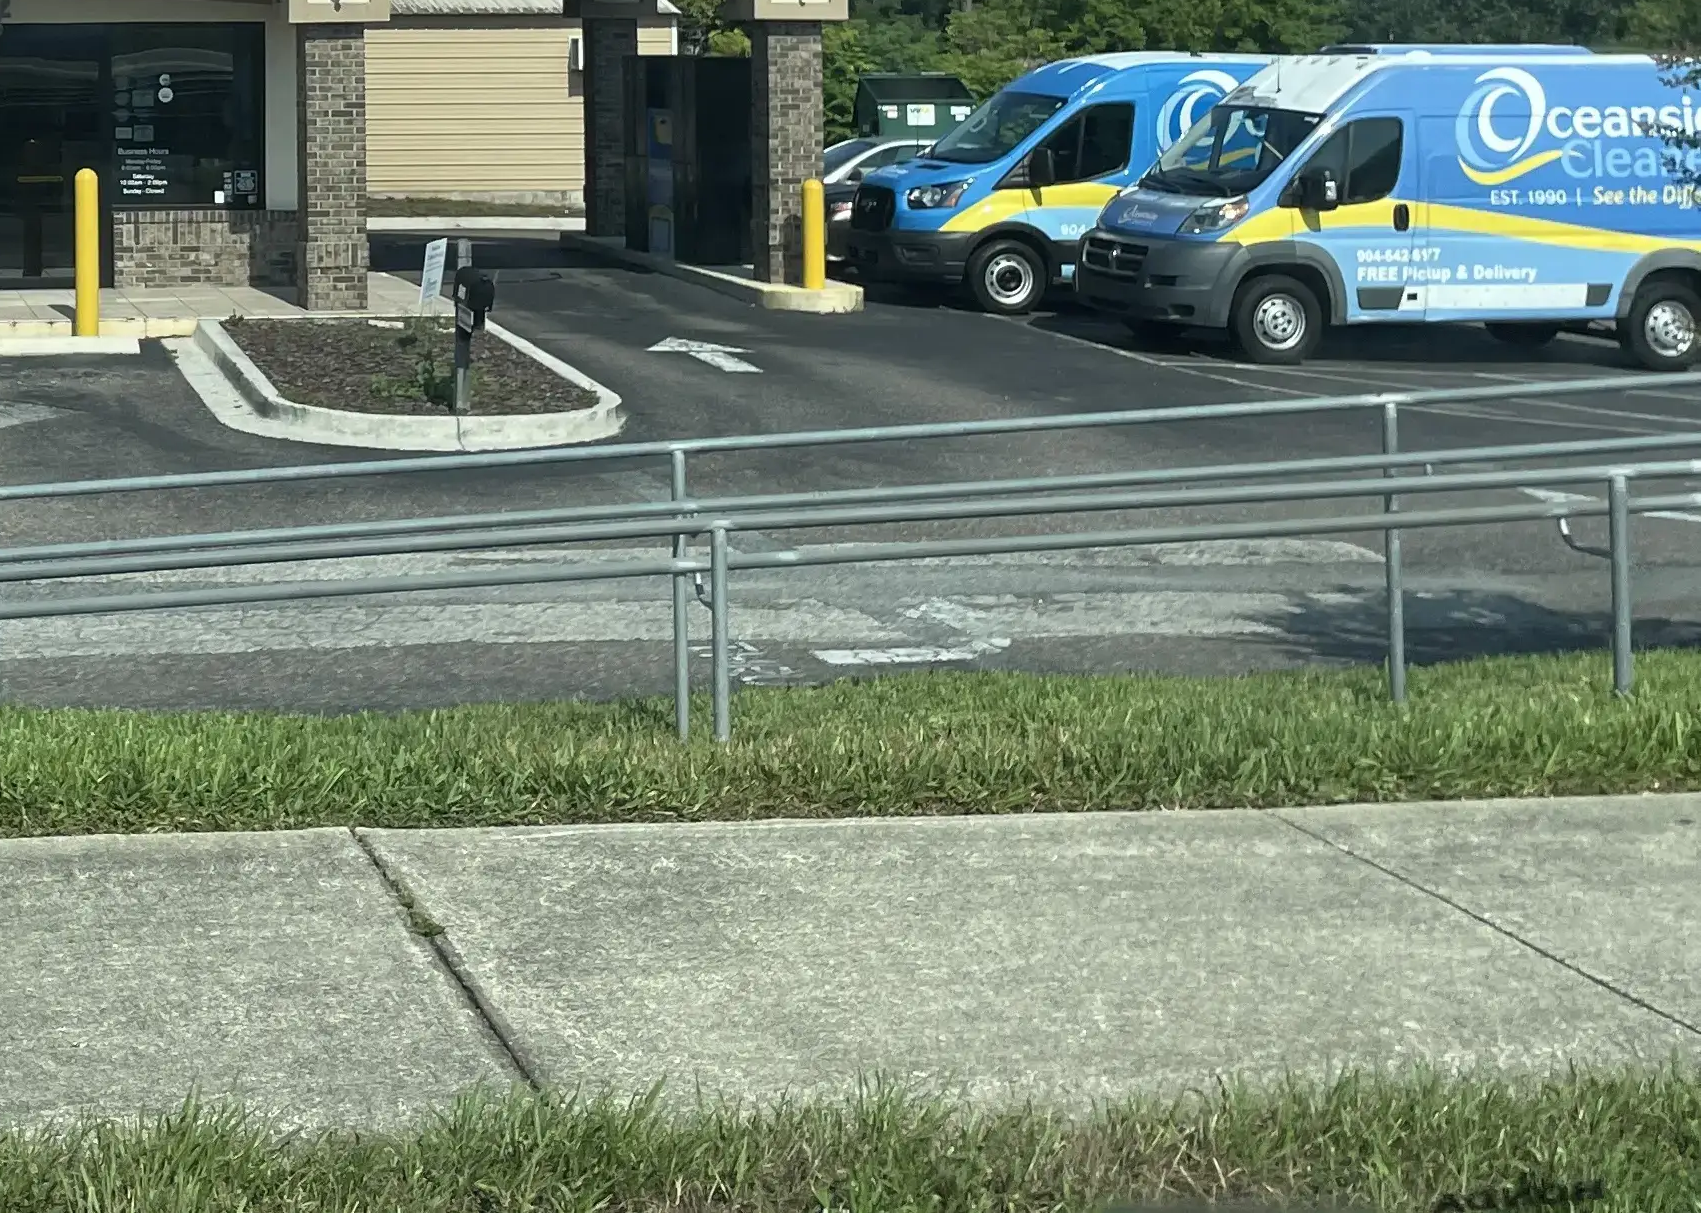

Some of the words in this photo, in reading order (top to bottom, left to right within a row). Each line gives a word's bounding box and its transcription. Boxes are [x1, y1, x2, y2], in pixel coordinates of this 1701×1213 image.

[1456, 66, 1701, 164] Oceansi
[149, 147, 170, 155] Hours
[1490, 189, 1523, 206] EST.
[1528, 189, 1567, 205] 1990
[1592, 186, 1624, 206] See
[1629, 185, 1657, 205] the
[1356, 266, 1399, 282] FREE
[1456, 264, 1468, 280] &
[1473, 264, 1538, 284] Delivery
